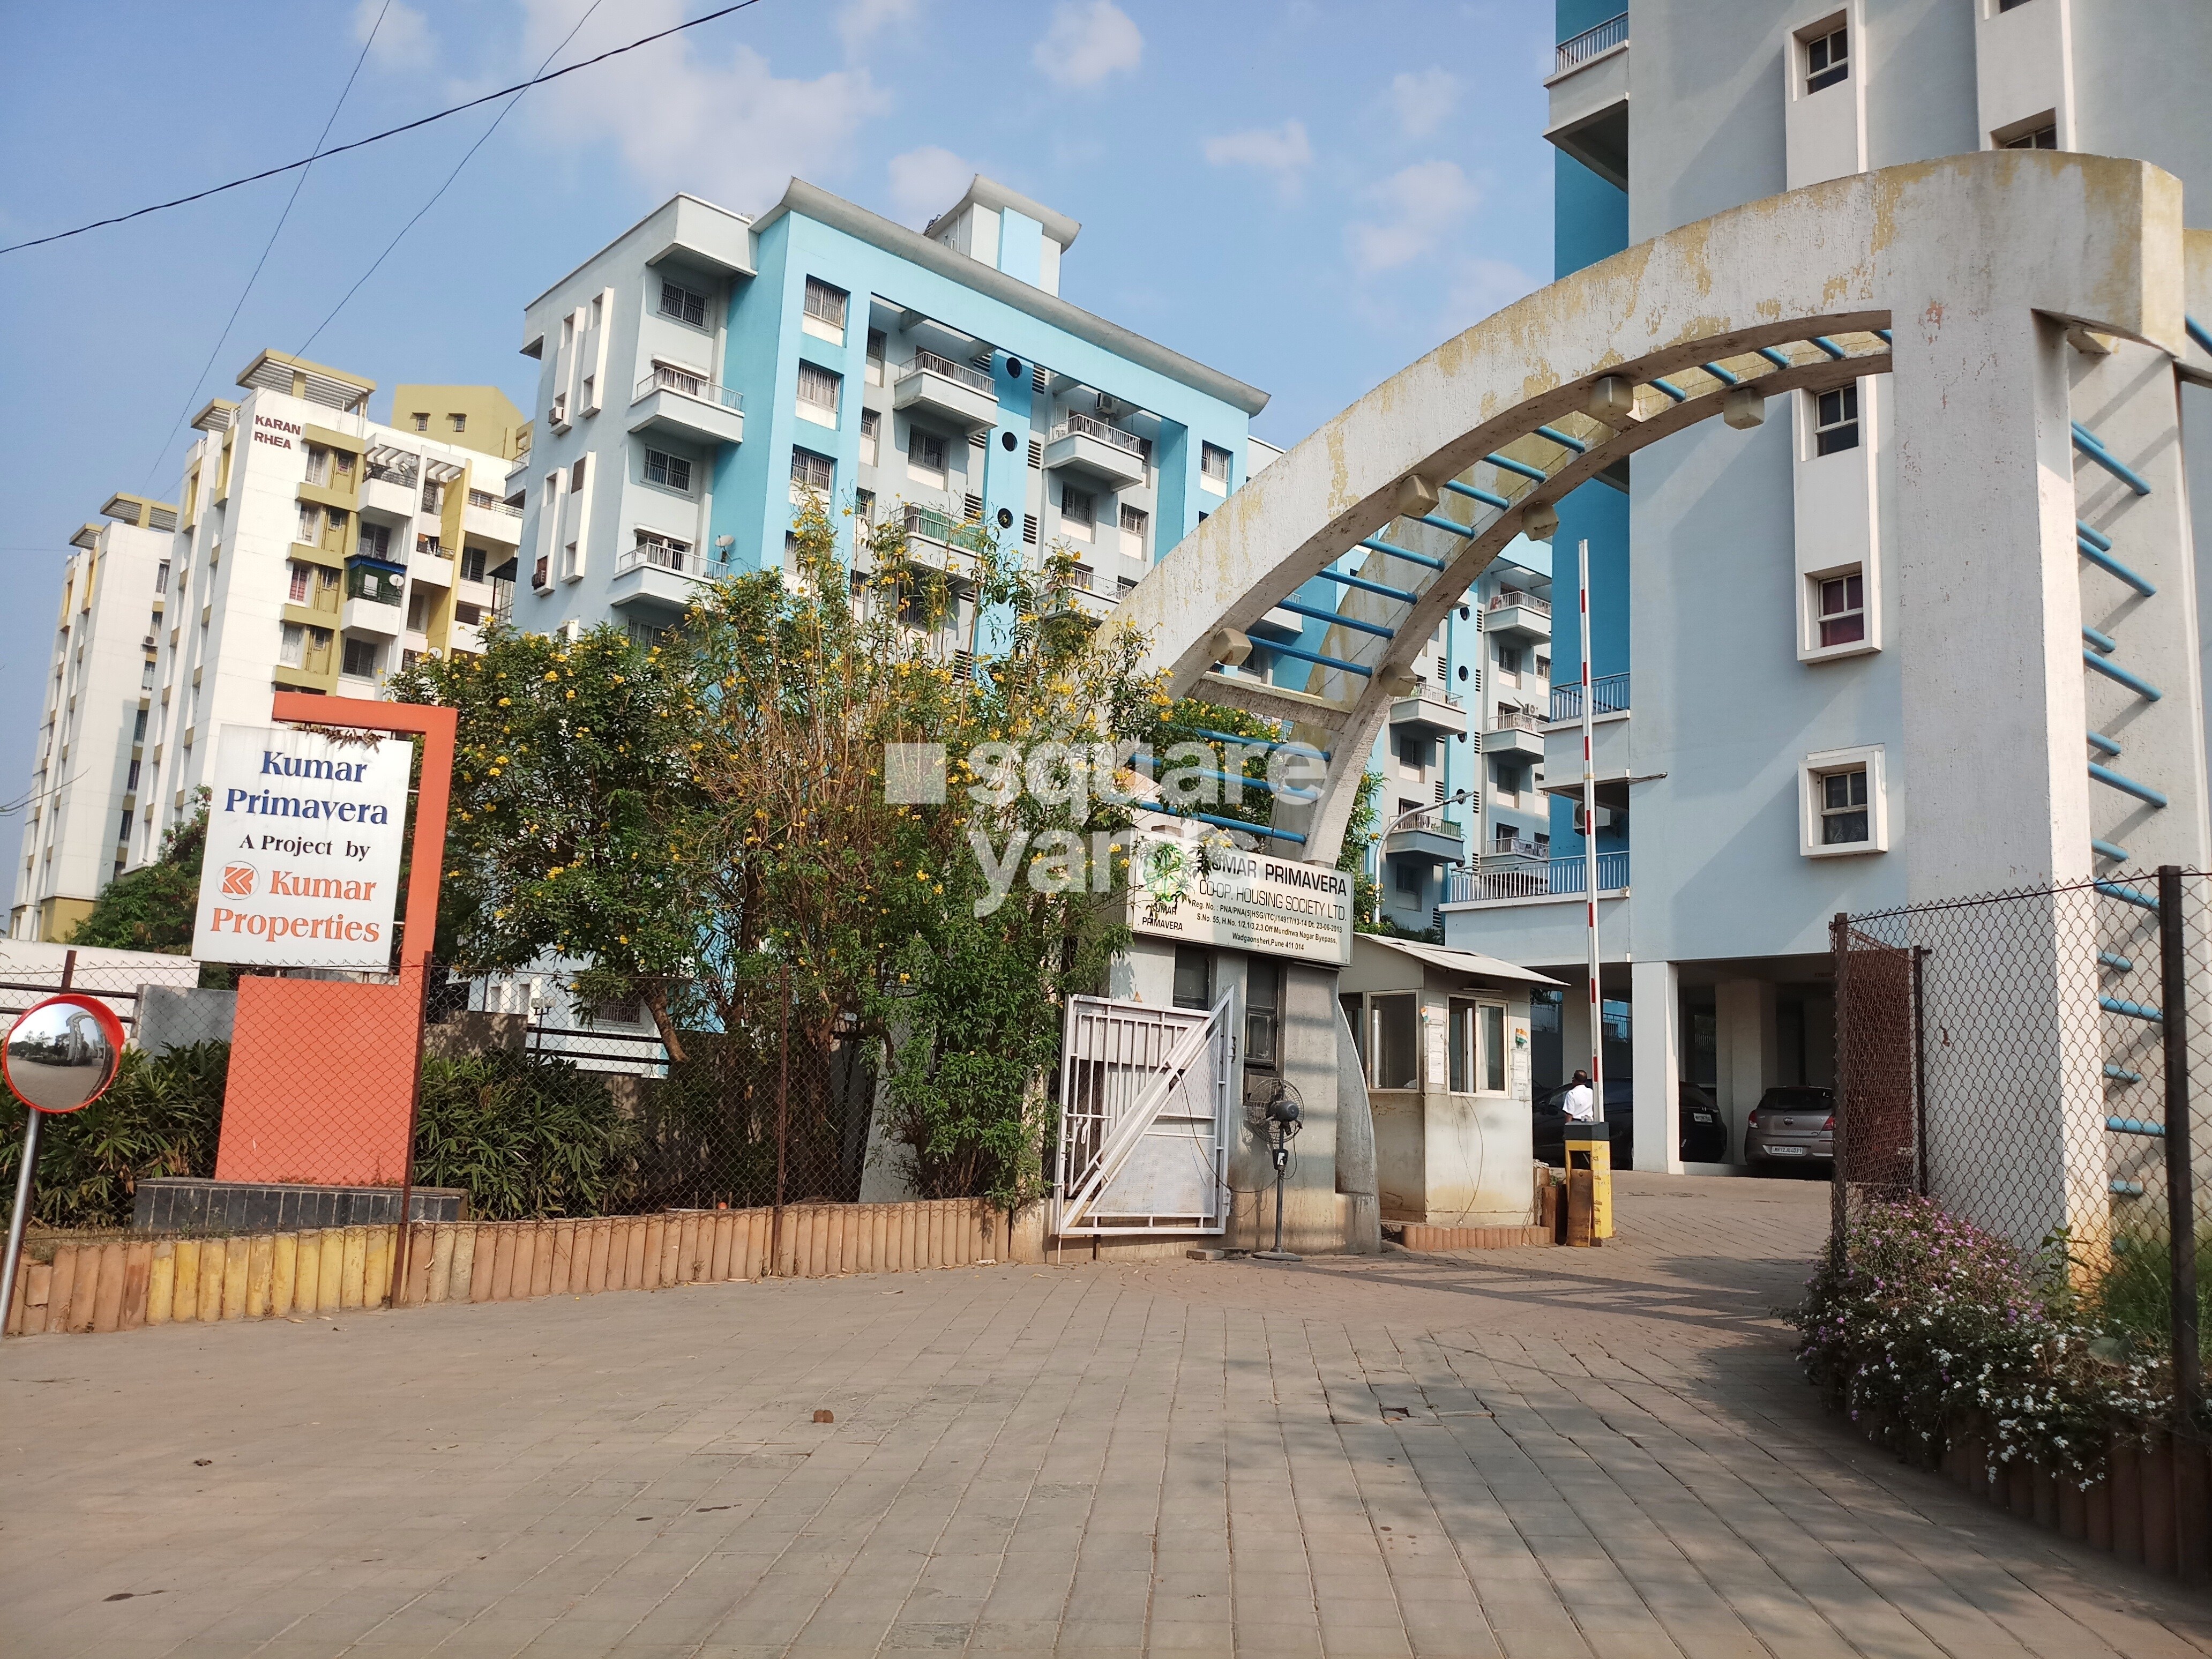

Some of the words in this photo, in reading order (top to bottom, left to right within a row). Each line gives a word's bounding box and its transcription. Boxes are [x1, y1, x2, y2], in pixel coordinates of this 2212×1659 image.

[254, 431, 292, 450] RHEA
[255, 415, 301, 435] KARAN
[260, 750, 368, 782] Kumar
[225, 788, 388, 824] Primavera
[239, 834, 254, 849] A
[261, 835, 333, 856] Project
[346, 841, 371, 862] by
[269, 870, 377, 901] Kumar
[1265, 863, 1347, 896] PRIMAVERA
[1200, 879, 1234, 900] CO-OP.
[1236, 886, 1283, 908] HOUSING
[1286, 895, 1325, 916] SOCIETY
[1328, 903, 1347, 921] LTD.
[210, 908, 380, 943] Properties
[1142, 916, 1183, 931] PRIMAVERA
[1192, 900, 1204, 910] Reg.
[1317, 922, 1342, 933] 23-06-2013
[1274, 926, 1298, 937] Mundhwa
[1299, 931, 1314, 940] Nagar
[1286, 941, 1294, 949] 411
[1295, 943, 1304, 951] 014
